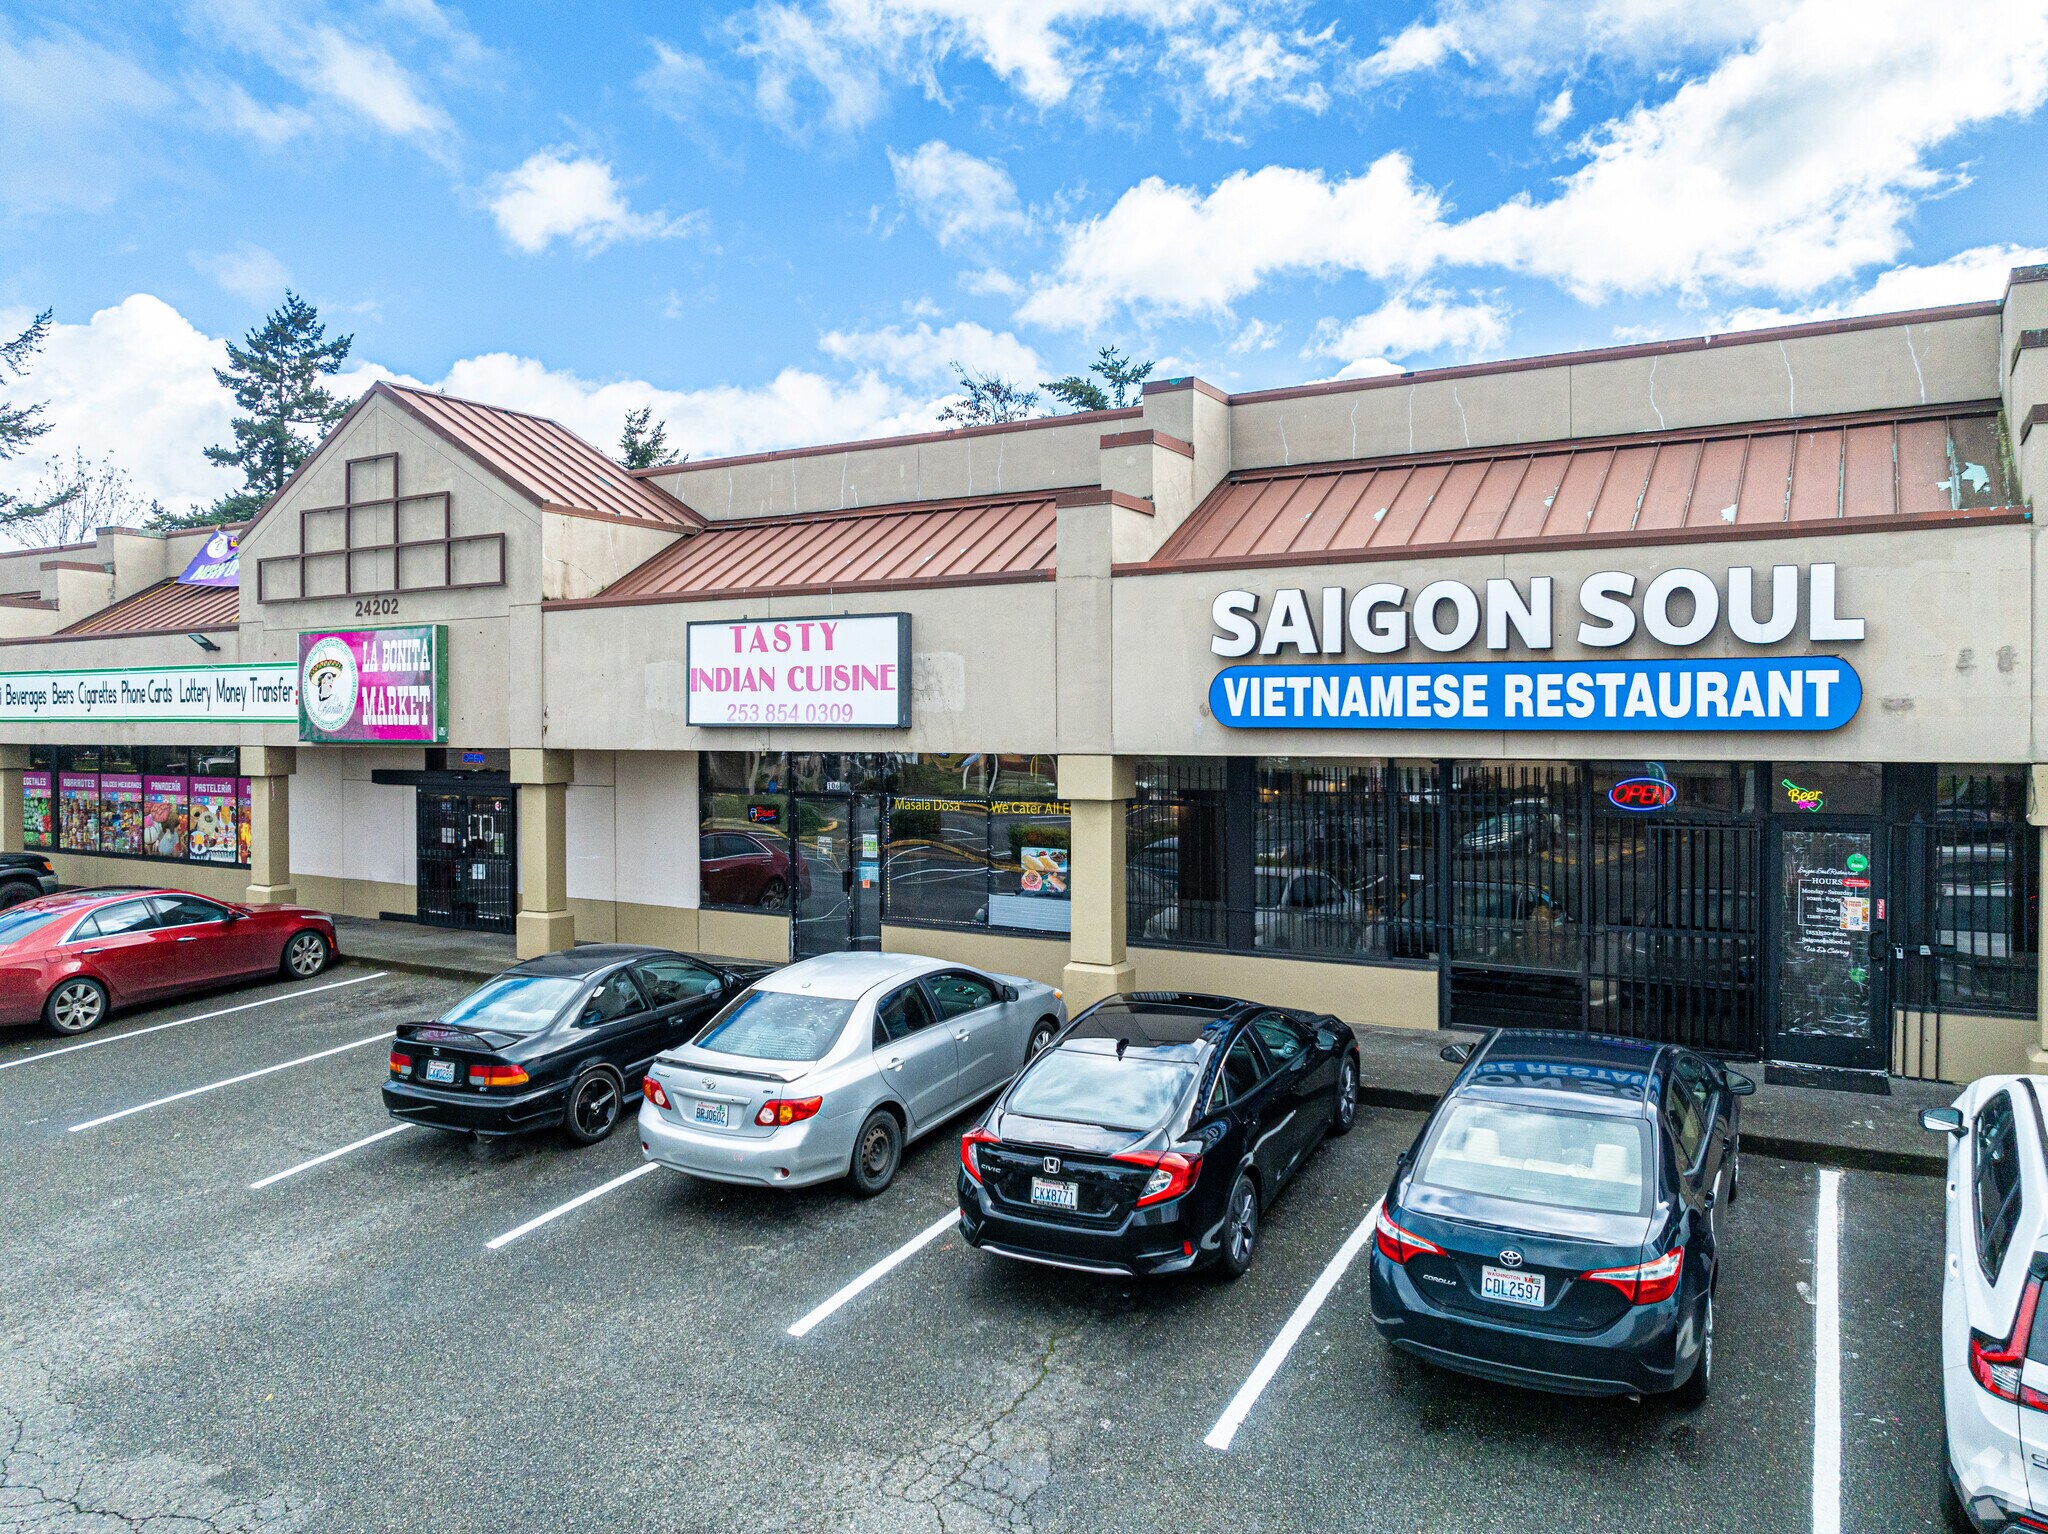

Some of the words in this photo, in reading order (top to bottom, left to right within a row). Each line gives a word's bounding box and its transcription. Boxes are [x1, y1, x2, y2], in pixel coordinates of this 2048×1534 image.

[355, 598, 399, 617] 24202
[1210, 575, 1554, 658] SAIGON
[1577, 562, 1866, 650] SOUL
[729, 621, 838, 654] TASTY
[362, 640, 378, 673] LA
[382, 638, 431, 673] BONITA
[690, 666, 775, 693] INDIAN
[787, 663, 896, 692] CUISINE
[6, 683, 47, 713] Beverages
[52, 681, 74, 705] Beers
[78, 681, 118, 713] Cigarettes
[121, 680, 146, 704] Phone
[148, 678, 173, 704] Cards
[180, 678, 211, 712] Lottery
[216, 677, 247, 712] Money
[249, 676, 293, 703] Transfer
[1222, 674, 1489, 718] VIETNAMESE
[1503, 668, 1840, 719] RESTAURANT
[362, 685, 431, 726] MARKET
[726, 703, 760, 723] 253
[765, 703, 799, 723] 854
[805, 703, 853, 723] 0309
[463, 752, 485, 763] OPEN
[101, 780, 117, 788] DULCES
[118, 781, 142, 789] MEXICANOS
[194, 781, 232, 793] PASTELERÍA
[827, 781, 840, 790] 106
[1612, 783, 1672, 805] OPEN
[1787, 788, 1823, 803] Beer
[756, 806, 777, 817] Beer
[894, 799, 931, 811] Masala
[933, 801, 961, 812] Dosa
[991, 802, 1009, 814] We
[1012, 802, 1042, 814] Cater
[1045, 803, 1060, 815] All
[1062, 803, 1071, 815] E
[1811, 877, 1843, 886] HOURS
[1827, 889, 1854, 897] Saturday
[696, 1107, 726, 1123] BRJ0602
[981, 1163, 1001, 1174] CIVIC
[1034, 1186, 1074, 1205] CKX8771
[1422, 1274, 1457, 1286] COROLLA
[1486, 1270, 1521, 1281] WASHINGTON
[1485, 1277, 1541, 1301] CDL2597
